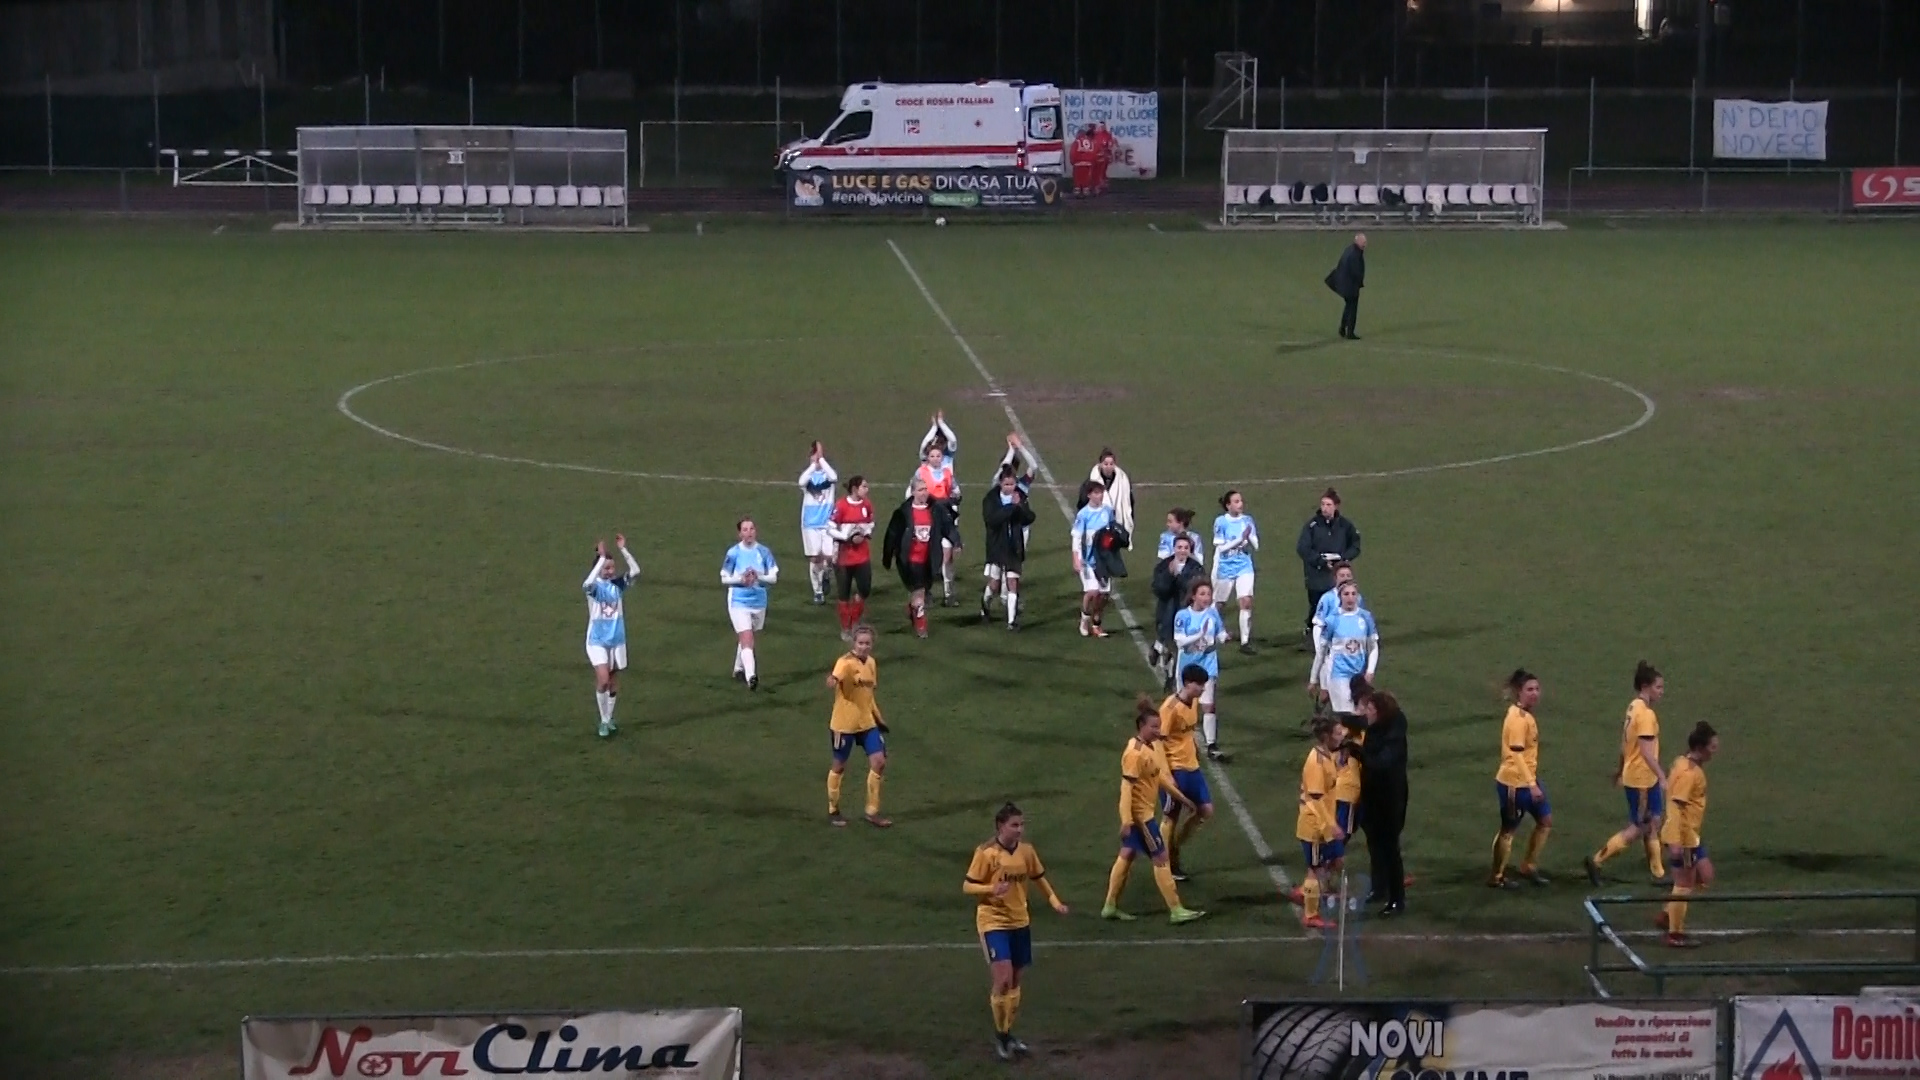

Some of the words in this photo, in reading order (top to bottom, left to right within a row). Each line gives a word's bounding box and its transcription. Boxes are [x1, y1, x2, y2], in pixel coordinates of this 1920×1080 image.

[895, 98, 924, 106] CROCE
[926, 98, 954, 106] ROSSA
[956, 97, 995, 106] ITALIANA
[1064, 92, 1085, 108] NOI
[1090, 94, 1113, 106] CON
[1116, 94, 1125, 106] IL
[1127, 95, 1157, 107] TIFO
[1064, 109, 1084, 122] VOI
[1089, 108, 1112, 120] CON
[1116, 108, 1126, 122] IL
[1721, 132, 1818, 156] NOVESE
[831, 174, 877, 189] LUCE
[881, 174, 891, 188] E
[895, 174, 932, 189] GAS
[935, 174, 952, 189] DI
[957, 174, 1000, 190] CASA
[1004, 174, 1039, 190] TUA
[831, 191, 923, 206] #energiavicina
[1648, 1015, 1712, 1029] riparazione
[1350, 1019, 1444, 1058] NOVI
[1832, 1005, 1920, 1061] Demi
[473, 1023, 699, 1074] Clima
[1653, 1047, 1693, 1058] marche
